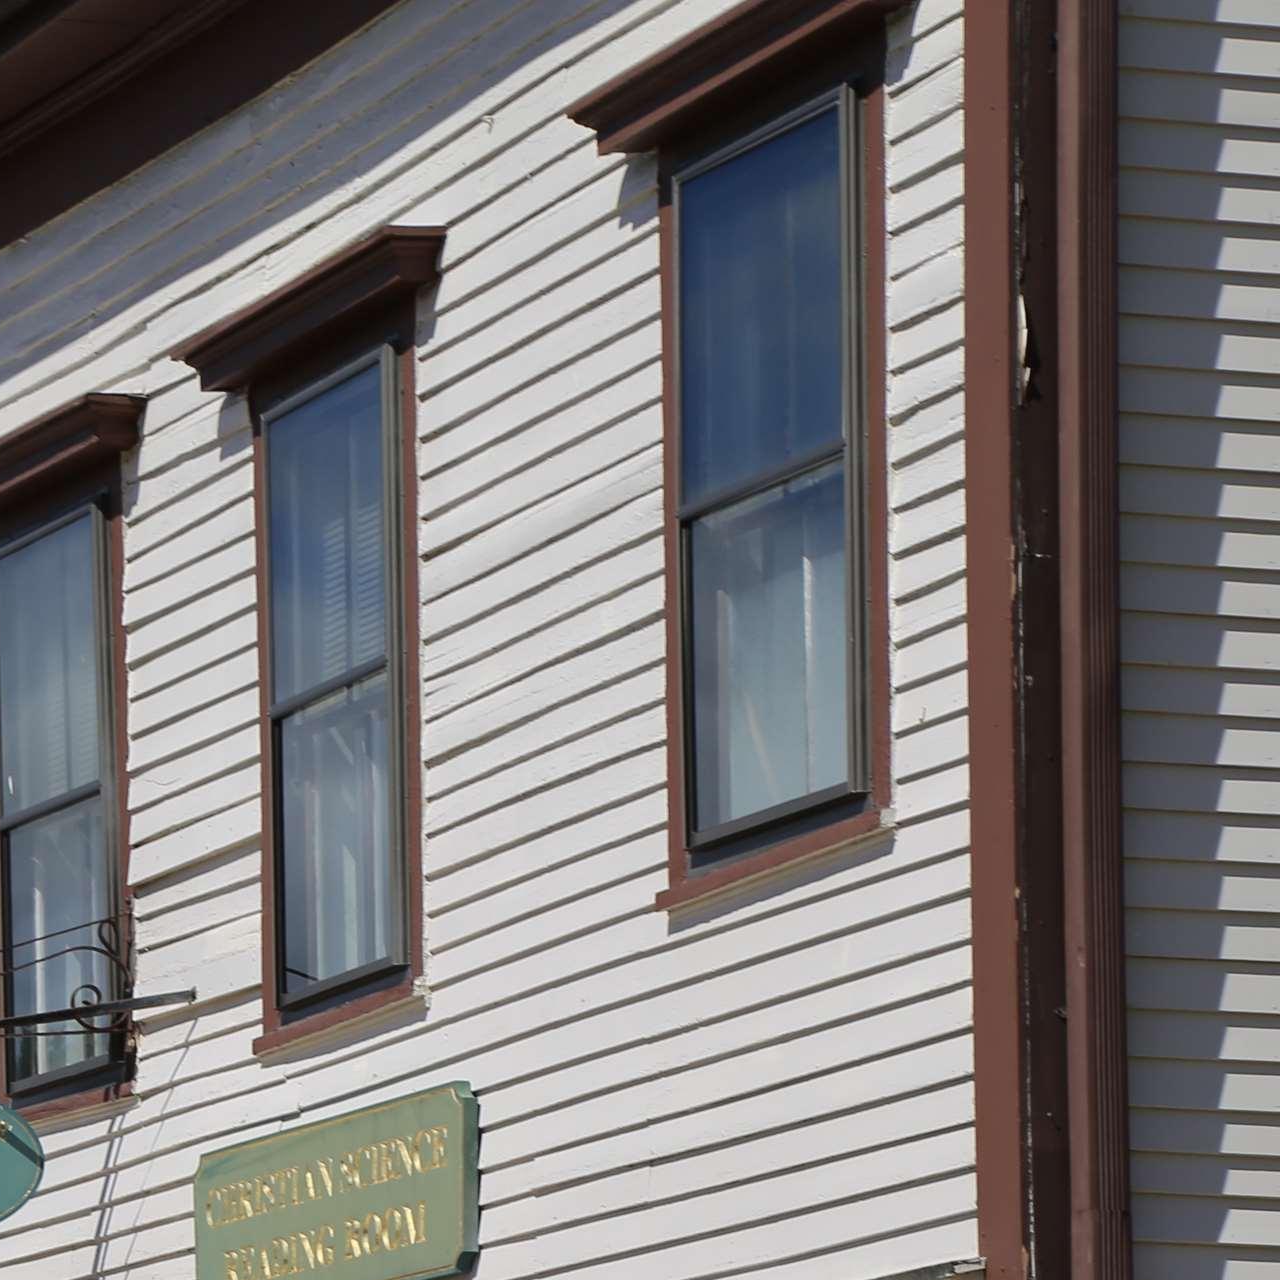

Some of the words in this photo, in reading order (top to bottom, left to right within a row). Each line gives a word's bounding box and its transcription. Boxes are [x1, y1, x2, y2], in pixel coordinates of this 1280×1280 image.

[206, 1156, 334, 1230] CHRISTIAN
[340, 1126, 449, 1193] SCIENCE
[343, 1199, 427, 1260] ROOM
